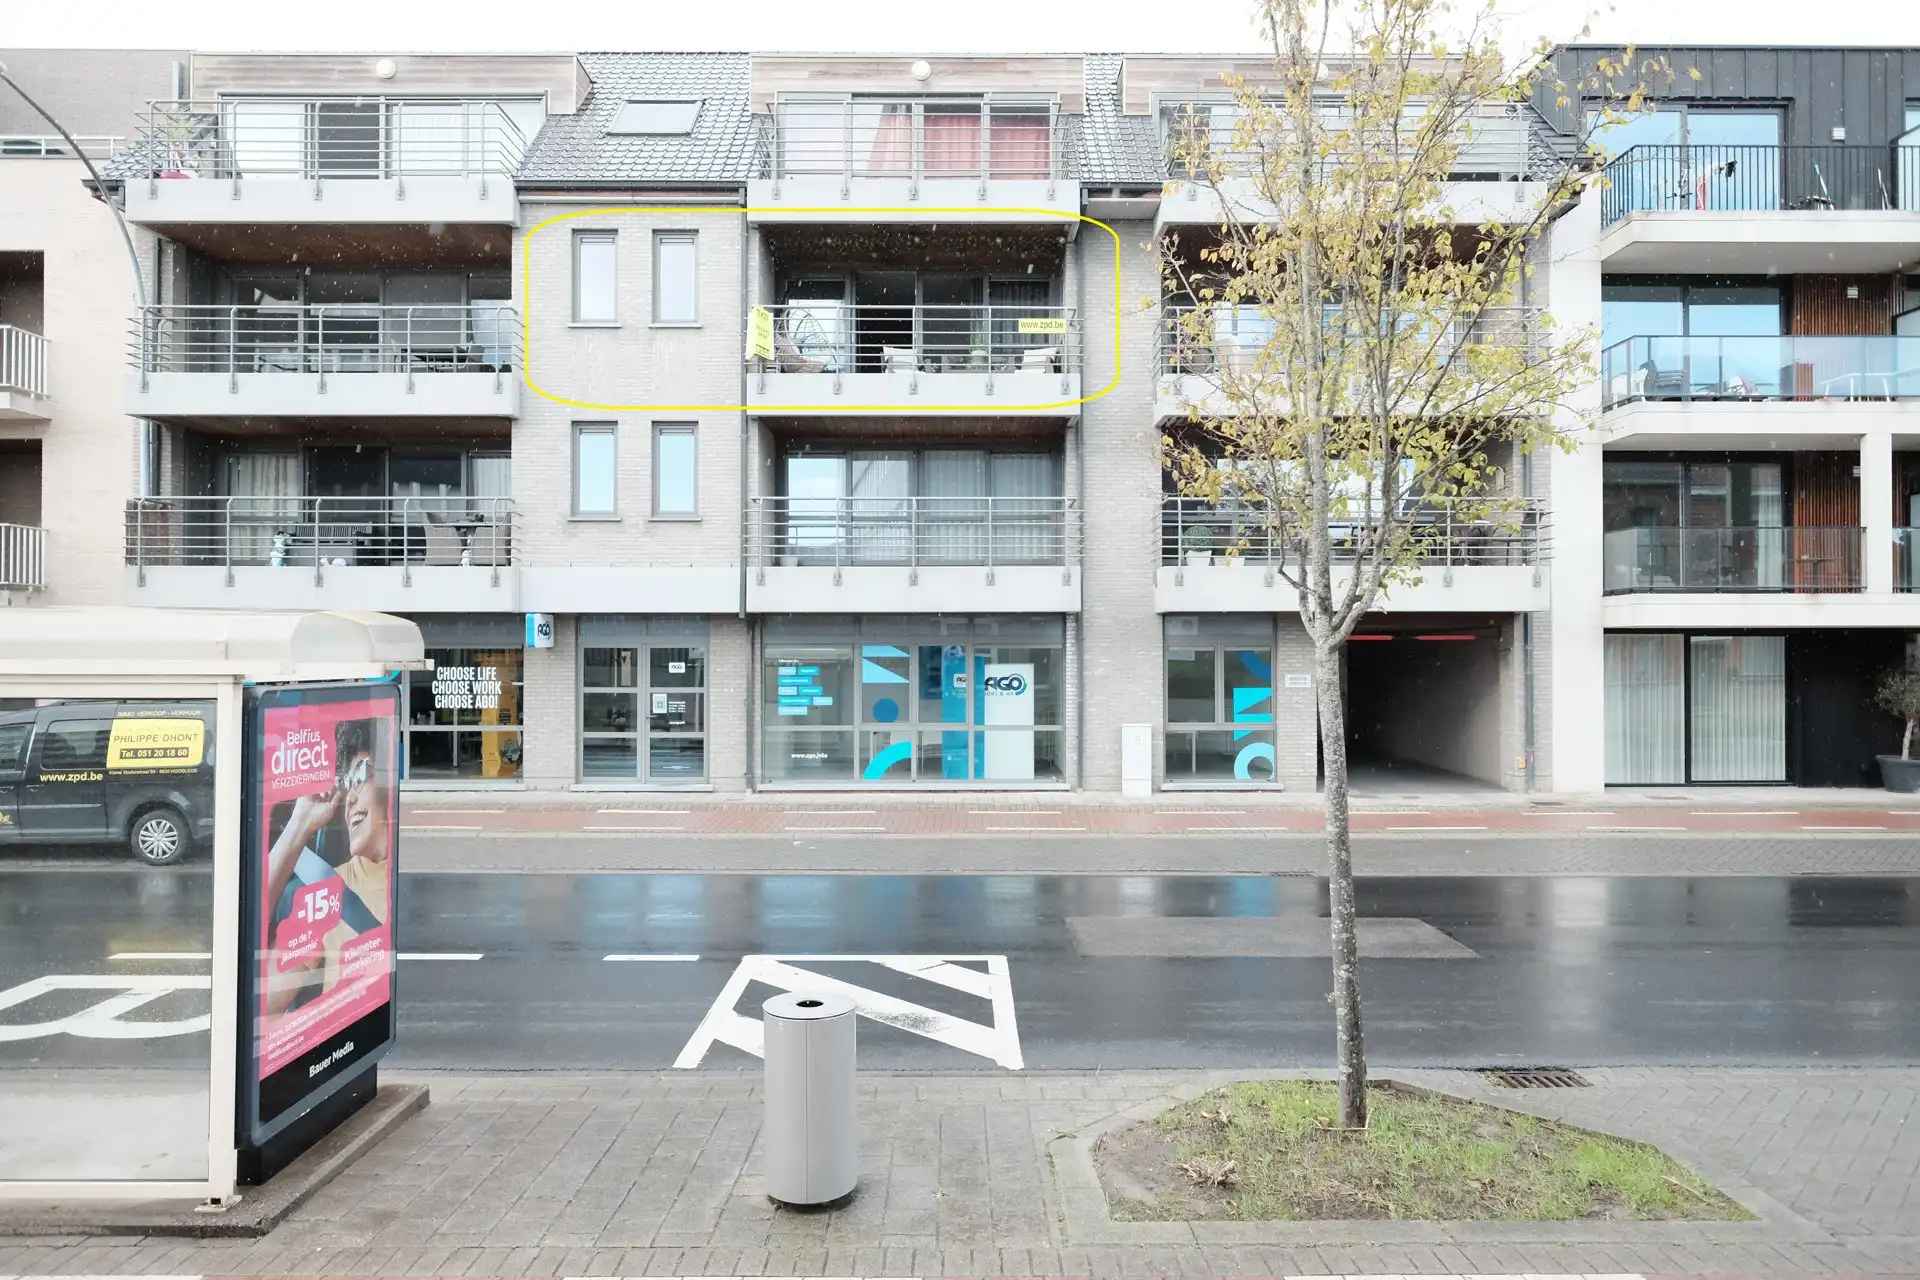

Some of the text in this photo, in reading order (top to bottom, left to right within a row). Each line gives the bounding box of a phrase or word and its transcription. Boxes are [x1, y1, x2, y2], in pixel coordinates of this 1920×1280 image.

[1020, 320, 1064, 331] www.zpd.be
[538, 622, 551, 638] AGO
[437, 666, 497, 680] CHOOSE LIFE
[432, 681, 502, 694] CHOOSE WORK
[984, 674, 1026, 693] AGO
[435, 695, 499, 708] CHOOSE AGO!
[113, 733, 200, 743] PHILIPPE DHONT
[287, 729, 321, 745] Belfius
[121, 750, 135, 758] Tel.
[166, 749, 175, 757] 18
[177, 749, 188, 757] 60
[271, 740, 329, 775] direct
[40, 772, 103, 783] www.zpd.be
[272, 770, 330, 790] VERZEKERINGEN
[298, 888, 340, 923] -15%
[288, 938, 298, 949] op
[299, 934, 308, 944] de
[309, 1055, 332, 1078] Bauer
[332, 1041, 355, 1063] Media
